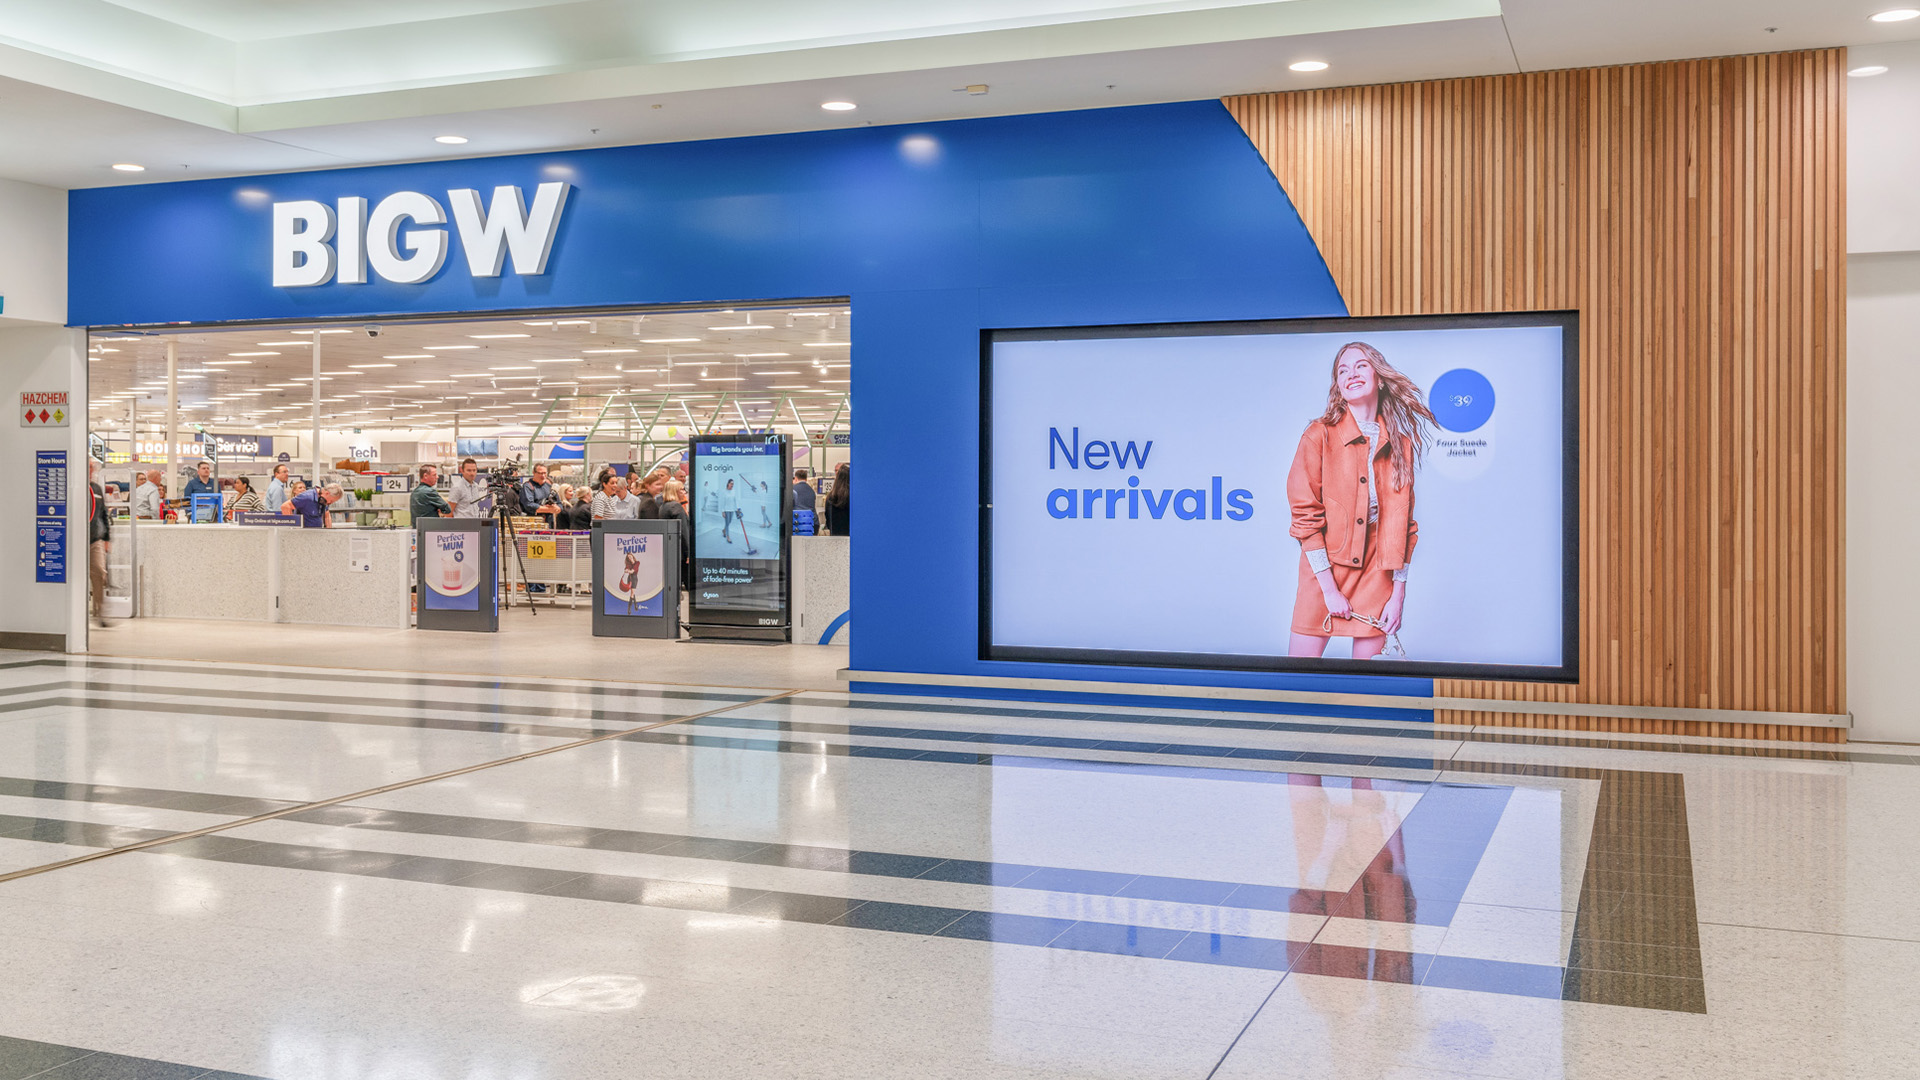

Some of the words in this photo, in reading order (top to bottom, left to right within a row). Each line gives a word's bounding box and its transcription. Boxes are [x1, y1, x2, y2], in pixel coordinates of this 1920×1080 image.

[22, 393, 67, 405] HAZCHEM
[1449, 394, 1473, 407] $39
[216, 437, 258, 454] Service
[1436, 439, 1458, 447] Faux
[1460, 439, 1487, 447] Suede
[349, 446, 378, 458] Tech
[711, 446, 721, 454] Big
[1048, 427, 1153, 470] New
[1447, 448, 1477, 457] Jacket
[714, 463, 733, 473] origin
[1045, 475, 1254, 521] arrivals
[437, 533, 465, 543] Perfect
[616, 535, 648, 547] Perfect
[443, 541, 464, 551] MUM
[623, 544, 646, 554] MUM
[702, 567, 711, 575] Up
